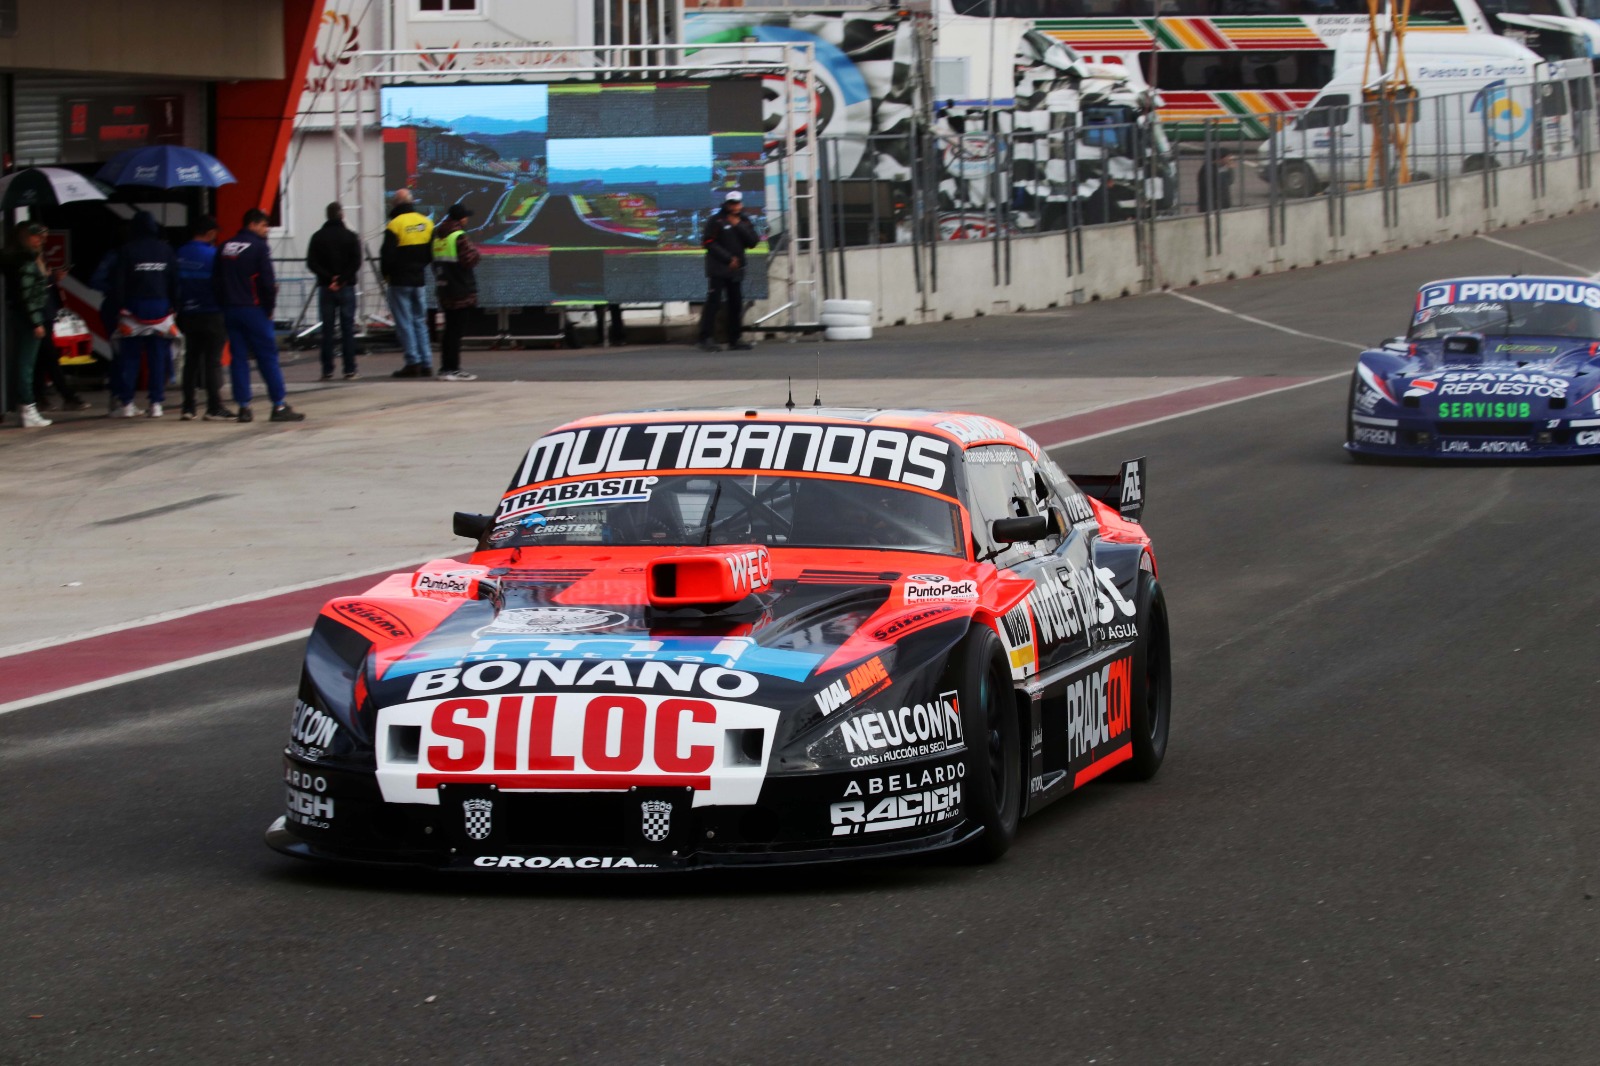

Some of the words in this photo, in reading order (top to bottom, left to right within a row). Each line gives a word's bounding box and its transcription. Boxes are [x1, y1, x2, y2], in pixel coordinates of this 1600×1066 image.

[1418, 66, 1469, 79] Puesta
[1485, 63, 1526, 77] Punto
[1459, 282, 1600, 309] PROVIDUS
[1438, 382, 1568, 399] REPUESTOS
[1443, 372, 1570, 389] SPATARO
[1438, 402, 1531, 419] SERVISUB
[518, 424, 950, 491] MULTIBANDAS
[503, 478, 649, 513] TRABASIL
[534, 524, 597, 534] CRISTEM
[726, 548, 772, 592] WEG
[907, 582, 973, 598] PuntoPack
[1108, 623, 1139, 640] AGUA
[407, 658, 760, 700] BONANO
[427, 695, 717, 773] SILOC
[840, 700, 944, 753] NEUCON
[919, 743, 929, 756] EN
[843, 761, 966, 797] ABELARDO
[829, 781, 961, 825] RACIGH
[473, 856, 638, 869] CROACIA
